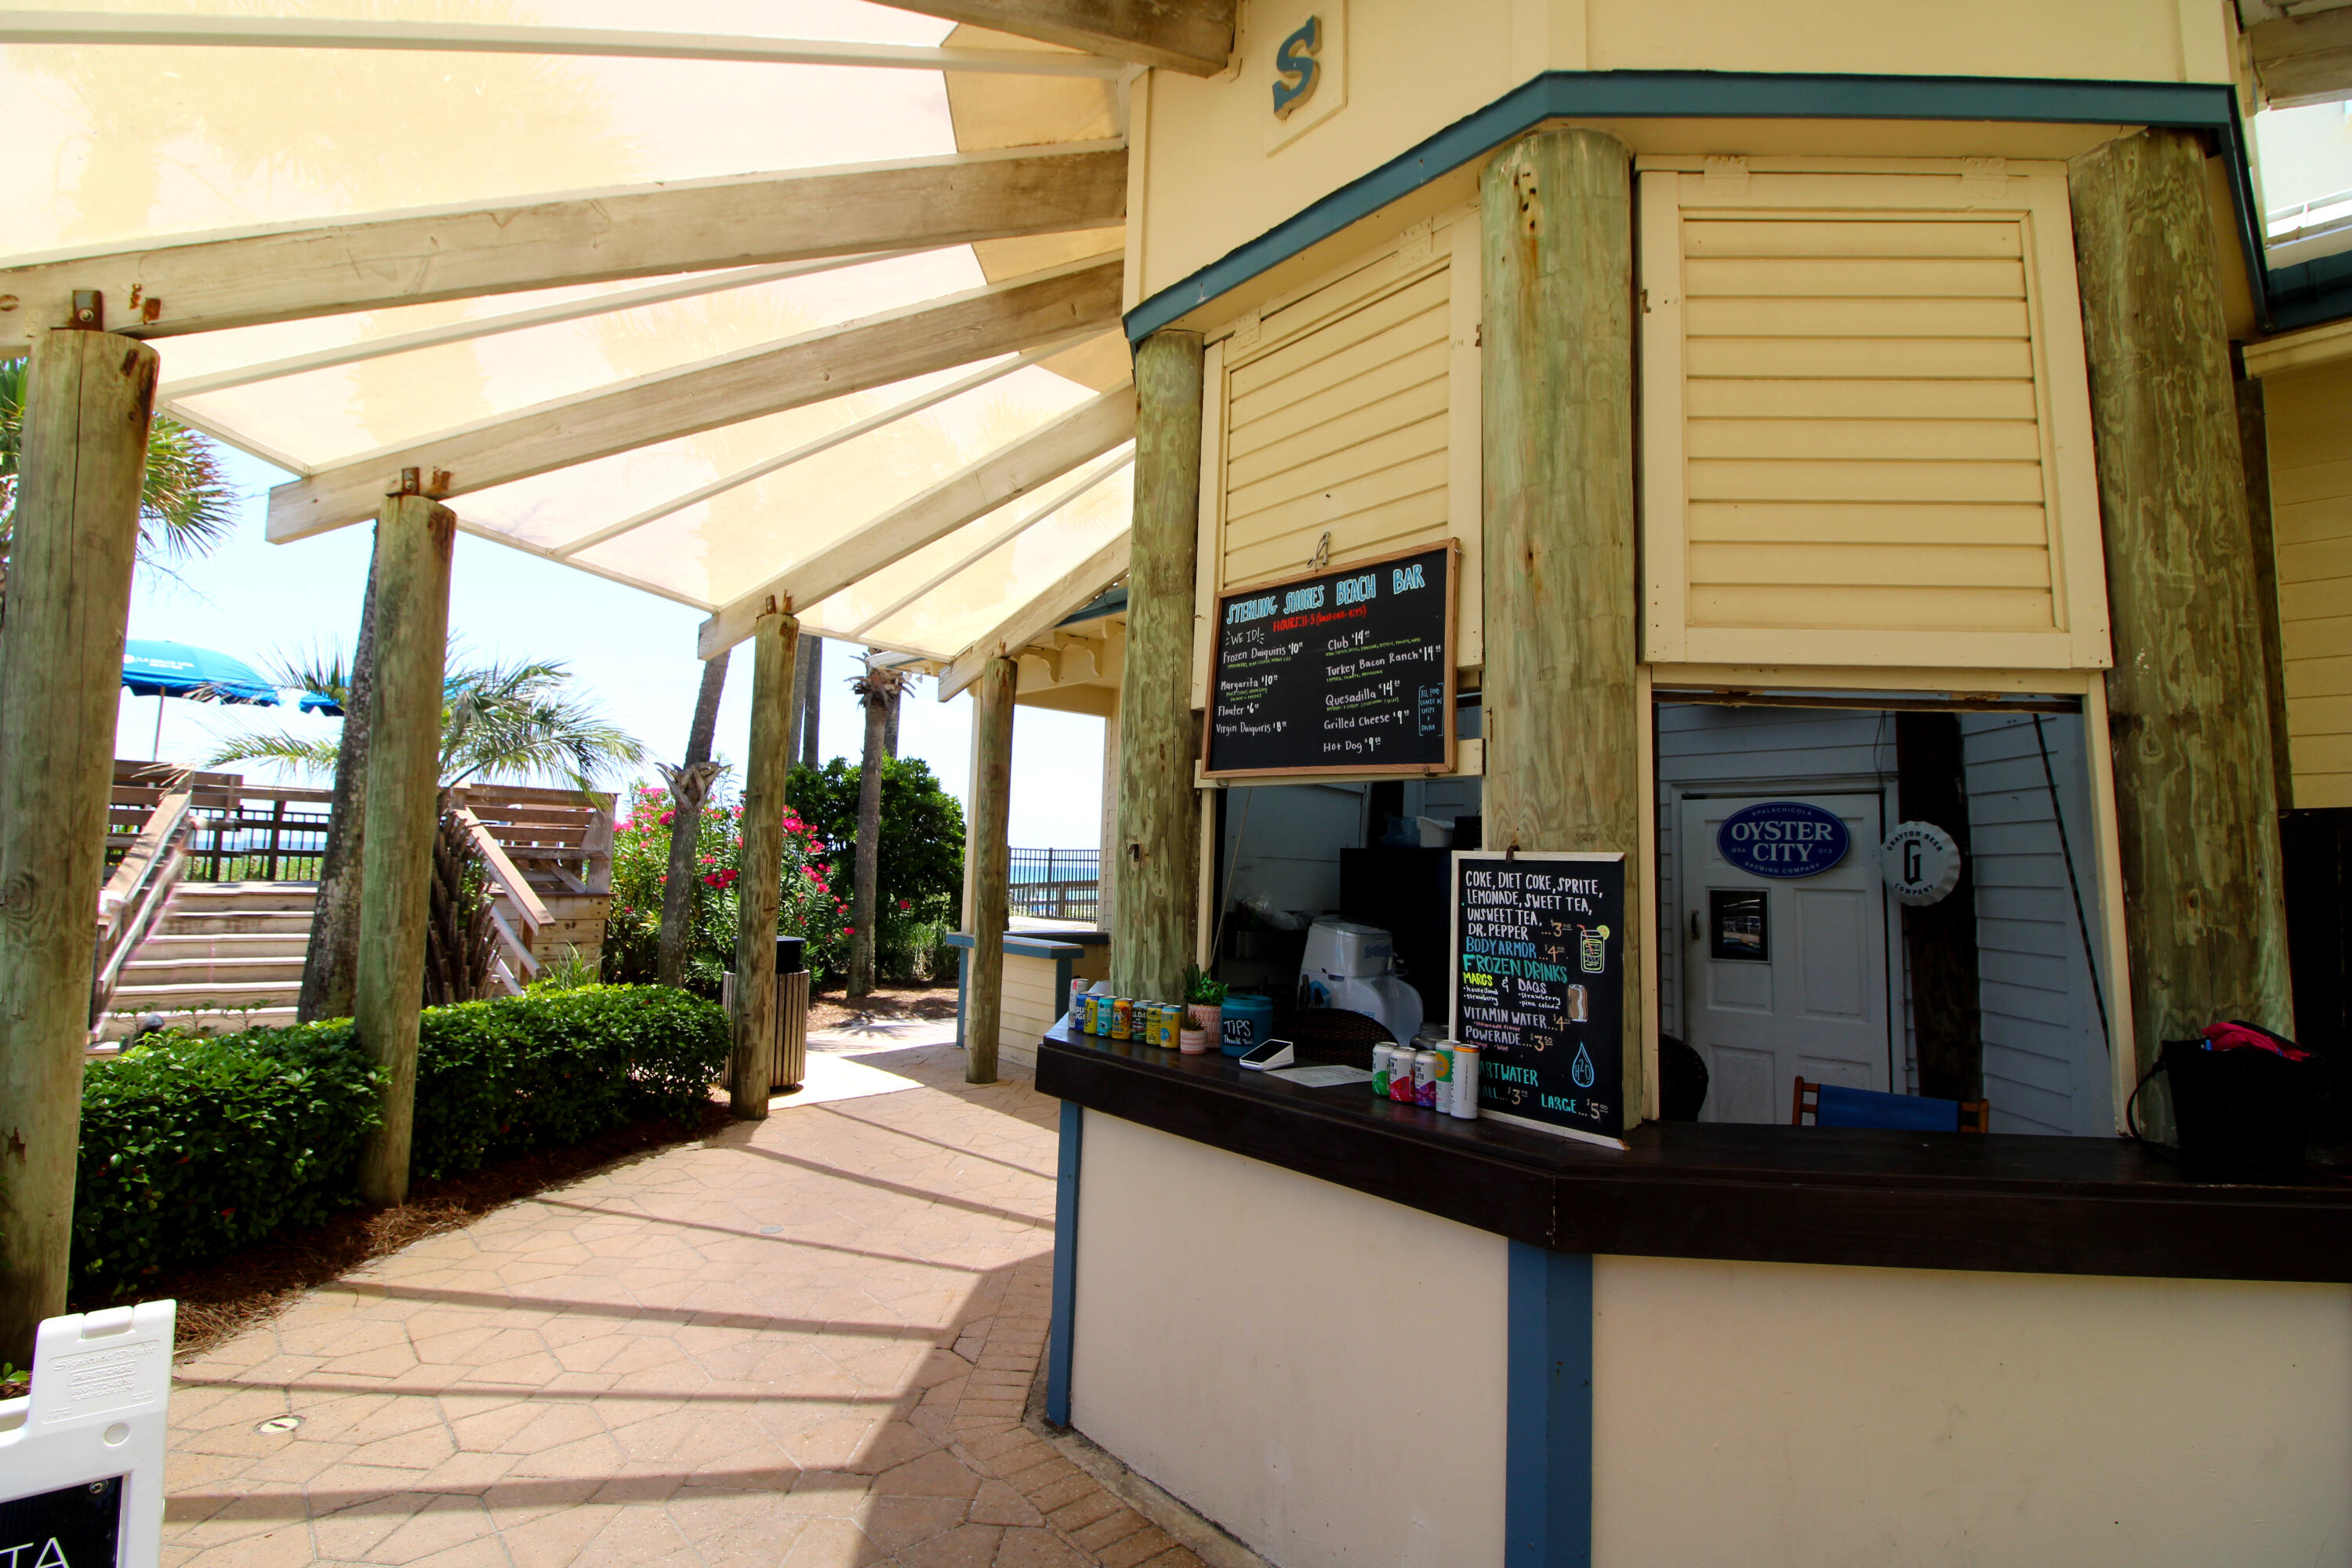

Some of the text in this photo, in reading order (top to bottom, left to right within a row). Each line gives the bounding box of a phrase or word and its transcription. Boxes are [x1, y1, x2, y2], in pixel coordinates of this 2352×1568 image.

[1272, 14, 1321, 120] S
[1226, 564, 1425, 625] STERLING SHORES BEACH BAR
[1231, 632, 1243, 645] WE
[1328, 636, 1348, 651] Club
[1223, 651, 1247, 664] Frozen
[1251, 644, 1286, 660] Daiquiris
[1327, 664, 1355, 677] Turkey
[1359, 659, 1385, 670] Bacon
[1389, 652, 1418, 663] Ranch
[1221, 677, 1258, 693] Margarita
[1326, 688, 1376, 706] Quesadilla
[1218, 705, 1245, 717] Floater
[1216, 723, 1237, 737] Virgin
[1240, 721, 1272, 736] Daiquiris
[1323, 717, 1355, 730] Grilled
[1359, 714, 1390, 726] Cheese
[1323, 742, 1341, 753] Hot
[1345, 741, 1363, 753] Dog
[1751, 807, 1812, 816] APALACHICOLA
[1731, 820, 1834, 840] OYSTER
[1887, 831, 1943, 852] GRAYTON BEER
[1752, 843, 1813, 862] CITY
[1744, 861, 1820, 873] BREWING COMPANY
[1904, 840, 1923, 885] G
[1466, 871, 1603, 898] COKE, DIET COKE, SPRITE,
[1895, 883, 1933, 895] COMPANY
[1467, 888, 1592, 916] LEMONADE, SWEET TEA,
[1467, 907, 1513, 924] UNSWEET
[1468, 923, 1486, 937] DR.
[1488, 924, 1529, 941] PEPPER
[1463, 954, 1567, 984] FROZEN DRINKS
[1463, 972, 1493, 986] MARGS
[1518, 978, 1547, 994] DAQS
[1521, 993, 1561, 1006] strawberry
[1463, 1006, 1508, 1022] VITAMIN
[1223, 1034, 1241, 1045] Thank
[1479, 1061, 1538, 1087] ARTWATER
